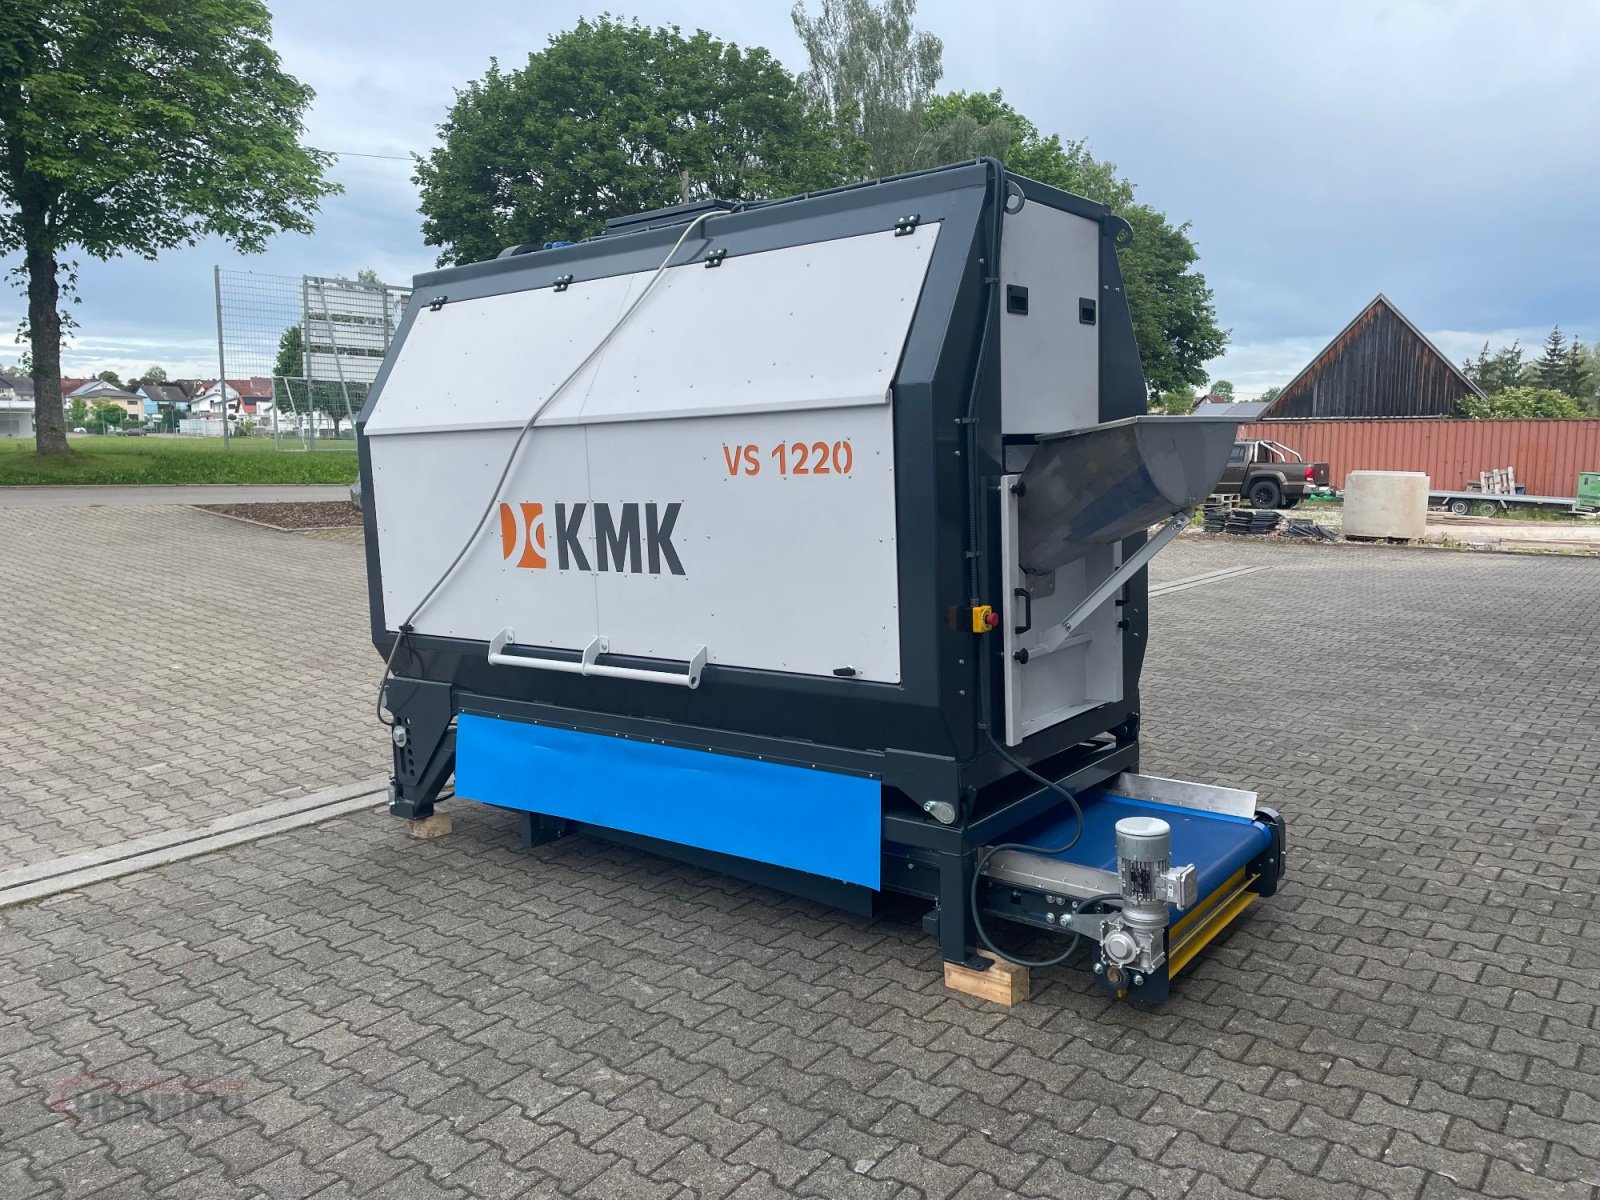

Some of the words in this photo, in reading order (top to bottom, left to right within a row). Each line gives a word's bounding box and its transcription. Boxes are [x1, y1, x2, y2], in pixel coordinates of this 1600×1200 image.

[723, 444, 760, 476] VS
[771, 440, 854, 475] 1220
[554, 502, 687, 576] KMK
